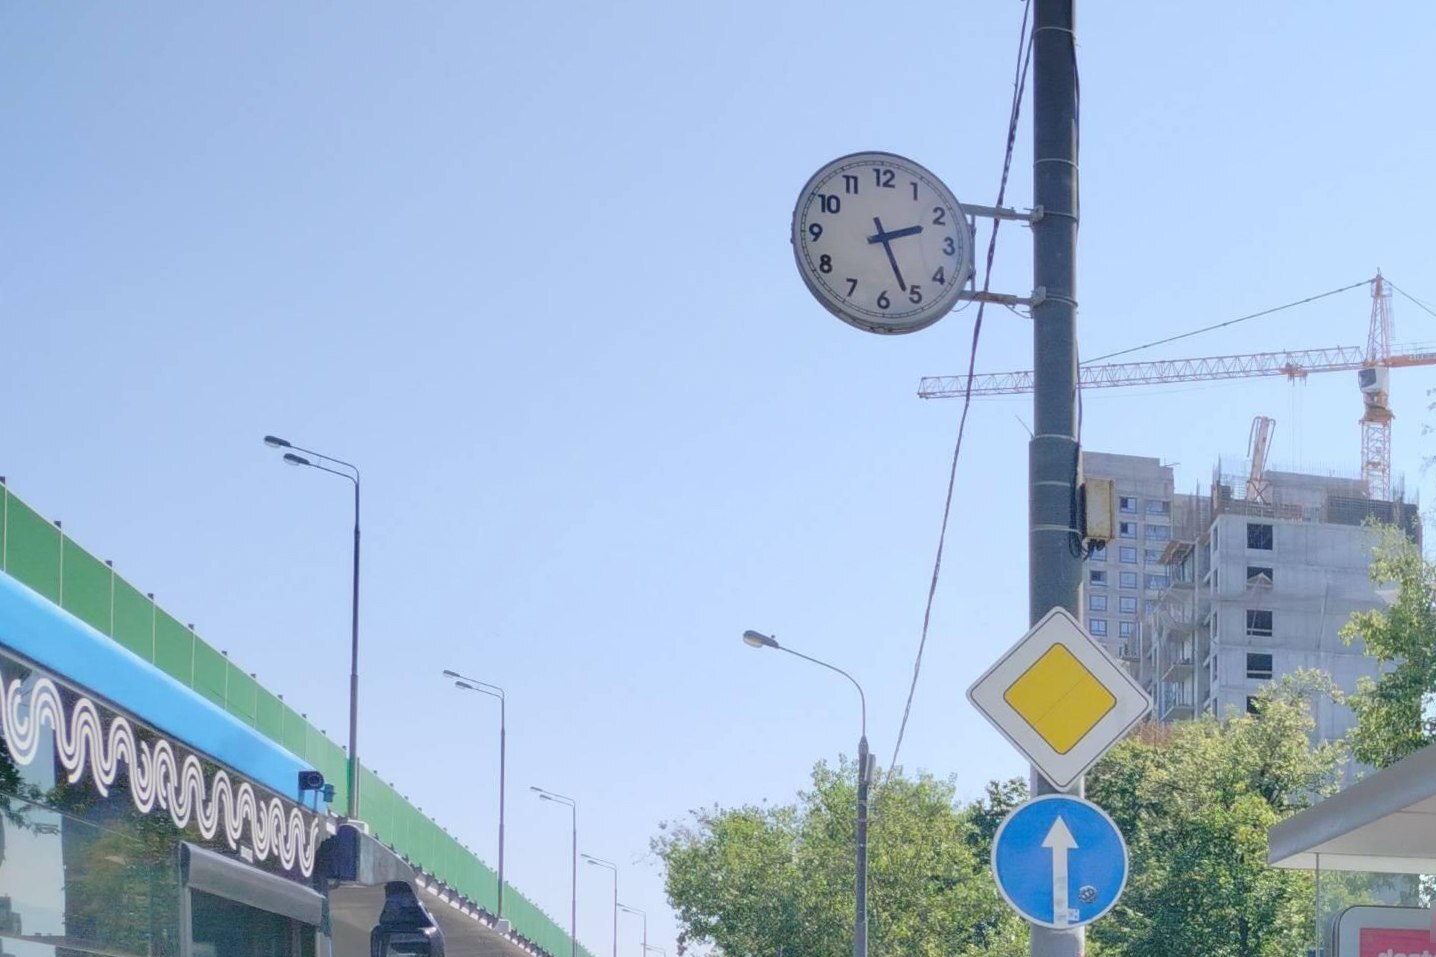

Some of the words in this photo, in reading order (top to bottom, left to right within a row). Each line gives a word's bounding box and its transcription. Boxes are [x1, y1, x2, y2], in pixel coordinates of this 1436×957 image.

[842, 174, 859, 195] 11
[872, 168, 896, 188] 12
[909, 181, 919, 201] 1
[817, 193, 841, 214] 10
[932, 206, 946, 226] 2
[808, 222, 823, 242] 9
[942, 236, 956, 256] 3
[819, 254, 833, 274] 8
[931, 266, 945, 286] 4
[846, 278, 858, 297] 7
[908, 284, 923, 304] 5
[876, 290, 891, 310] 6
